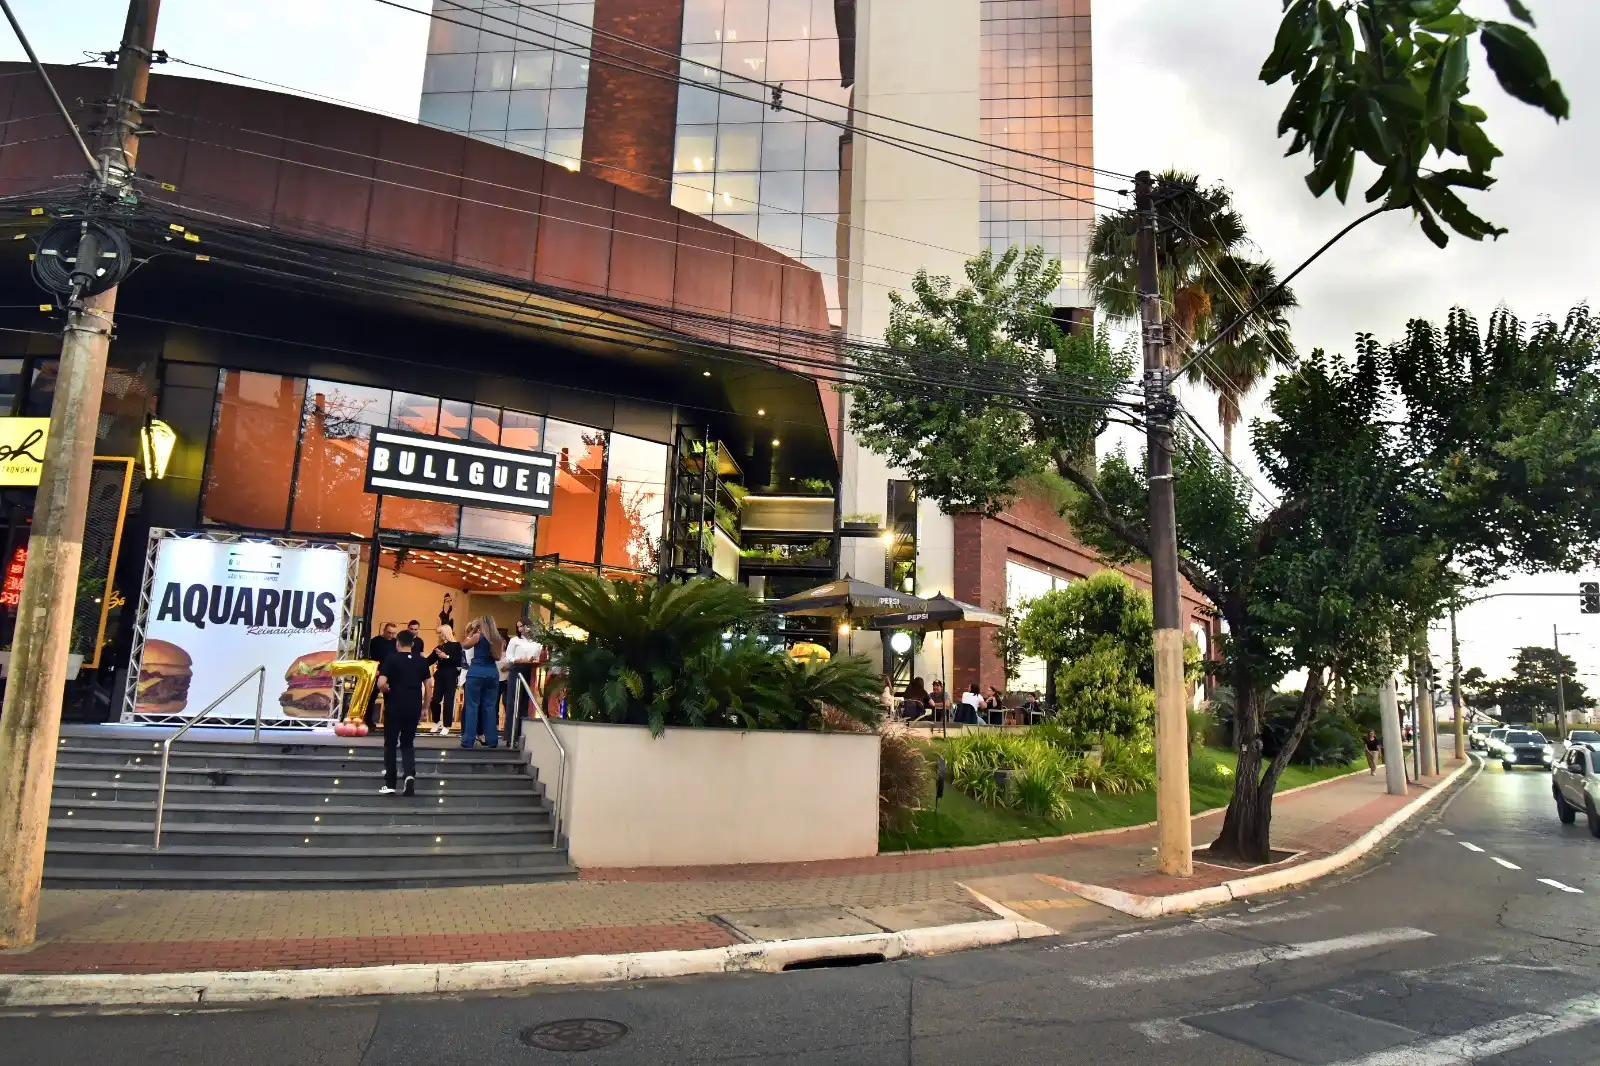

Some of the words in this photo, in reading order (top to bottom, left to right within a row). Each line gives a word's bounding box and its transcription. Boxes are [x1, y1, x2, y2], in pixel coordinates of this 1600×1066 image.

[372, 446, 552, 495] BULLGUER
[156, 582, 336, 630] AQUARIUS
[879, 597, 900, 605] PEPSI
[907, 613, 929, 621] PEPSI
[331, 659, 380, 720] 7
